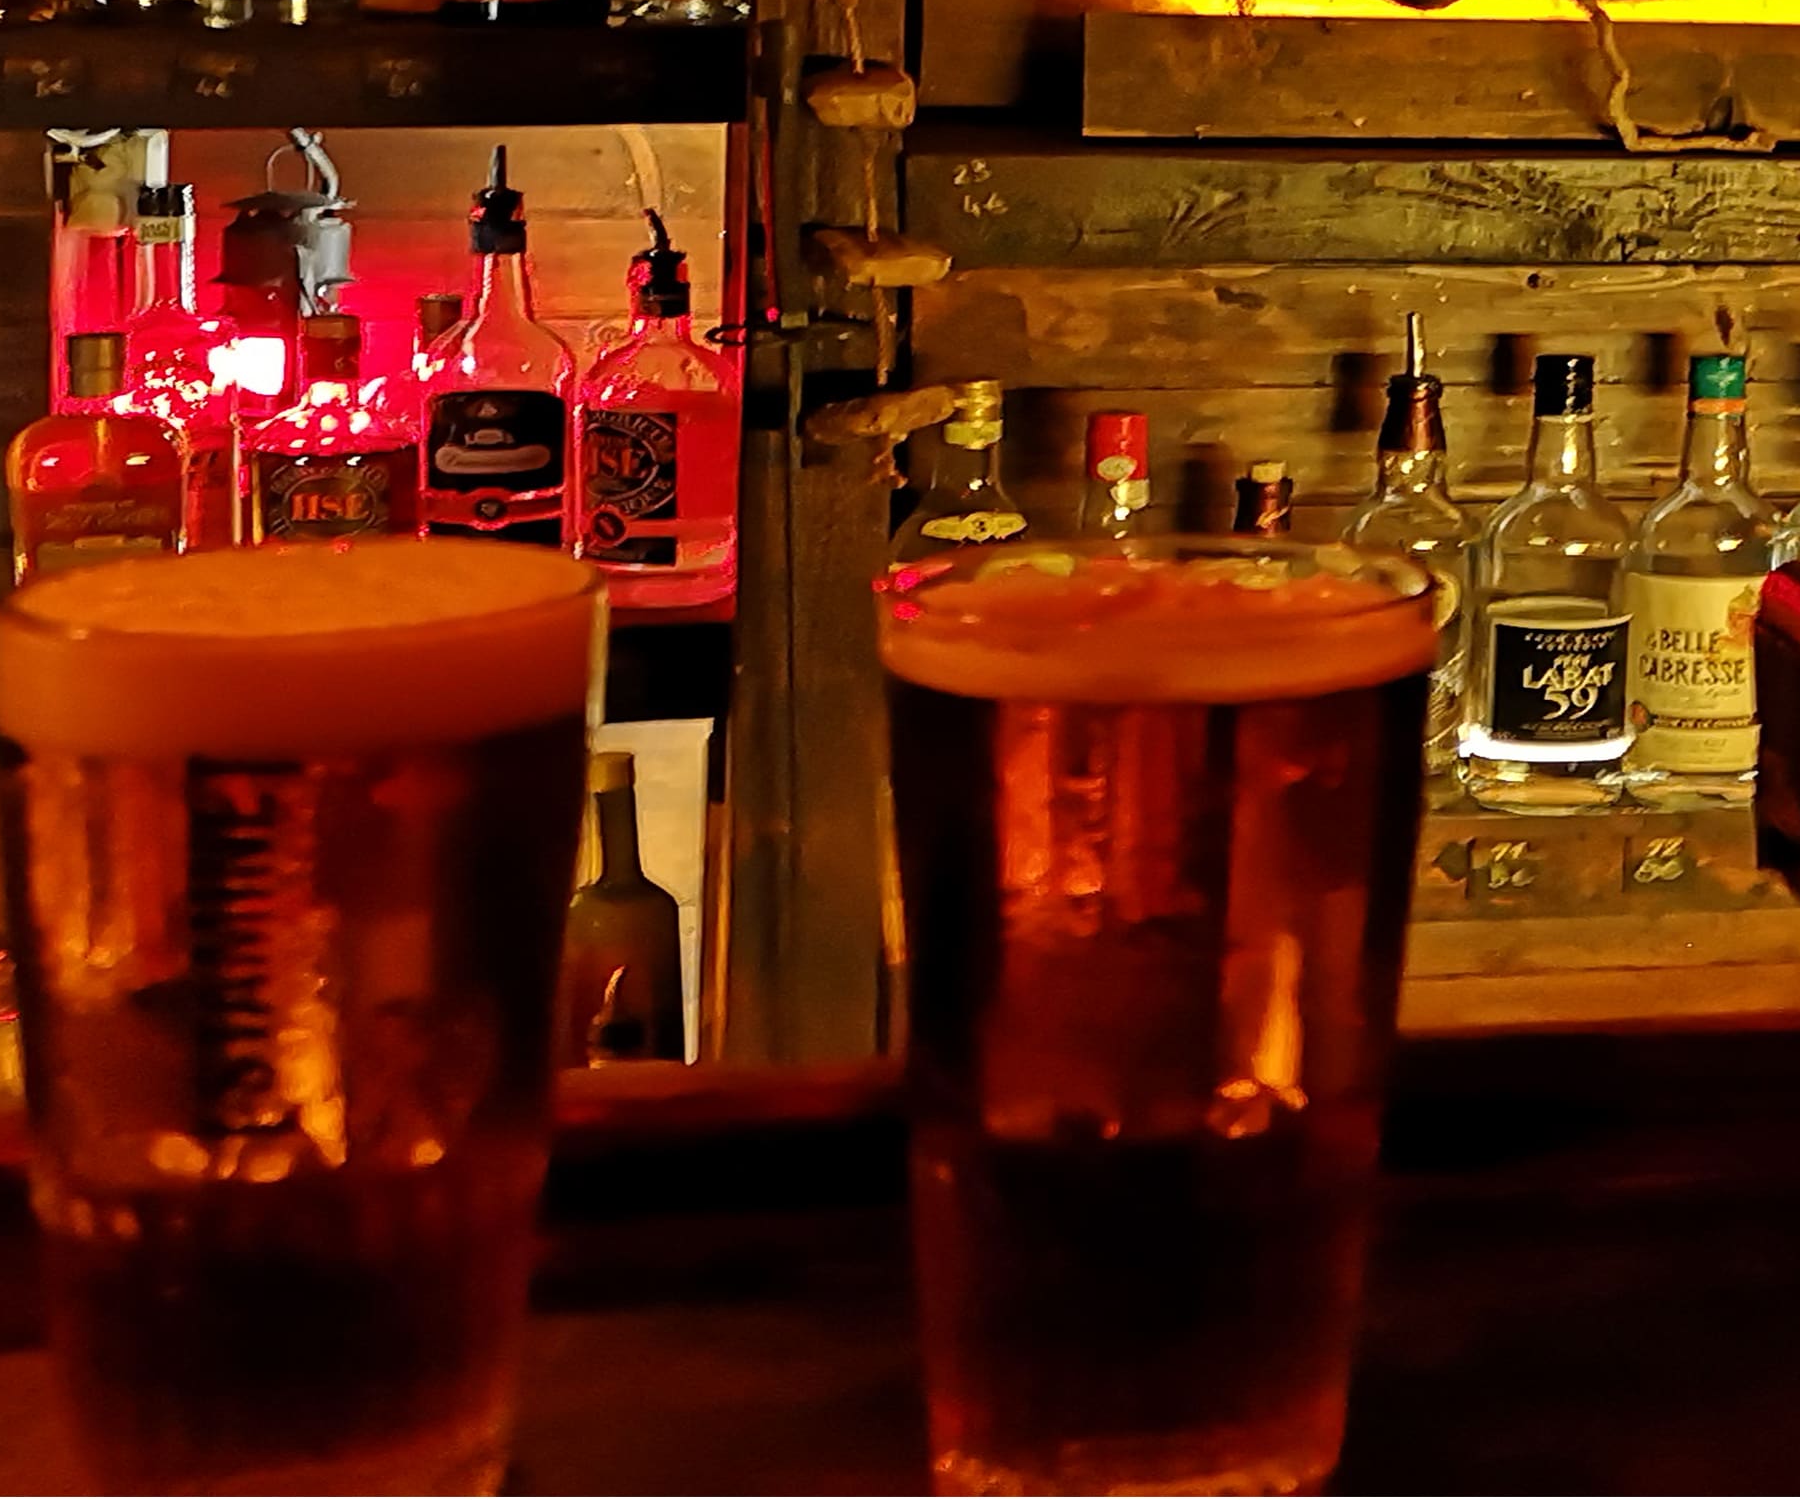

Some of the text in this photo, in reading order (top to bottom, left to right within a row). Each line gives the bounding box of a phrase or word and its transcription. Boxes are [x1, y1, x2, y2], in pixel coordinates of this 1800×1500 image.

[1659, 629, 1721, 654] BELLE
[1522, 662, 1617, 689] LABAT
[1542, 684, 1599, 720] 59
